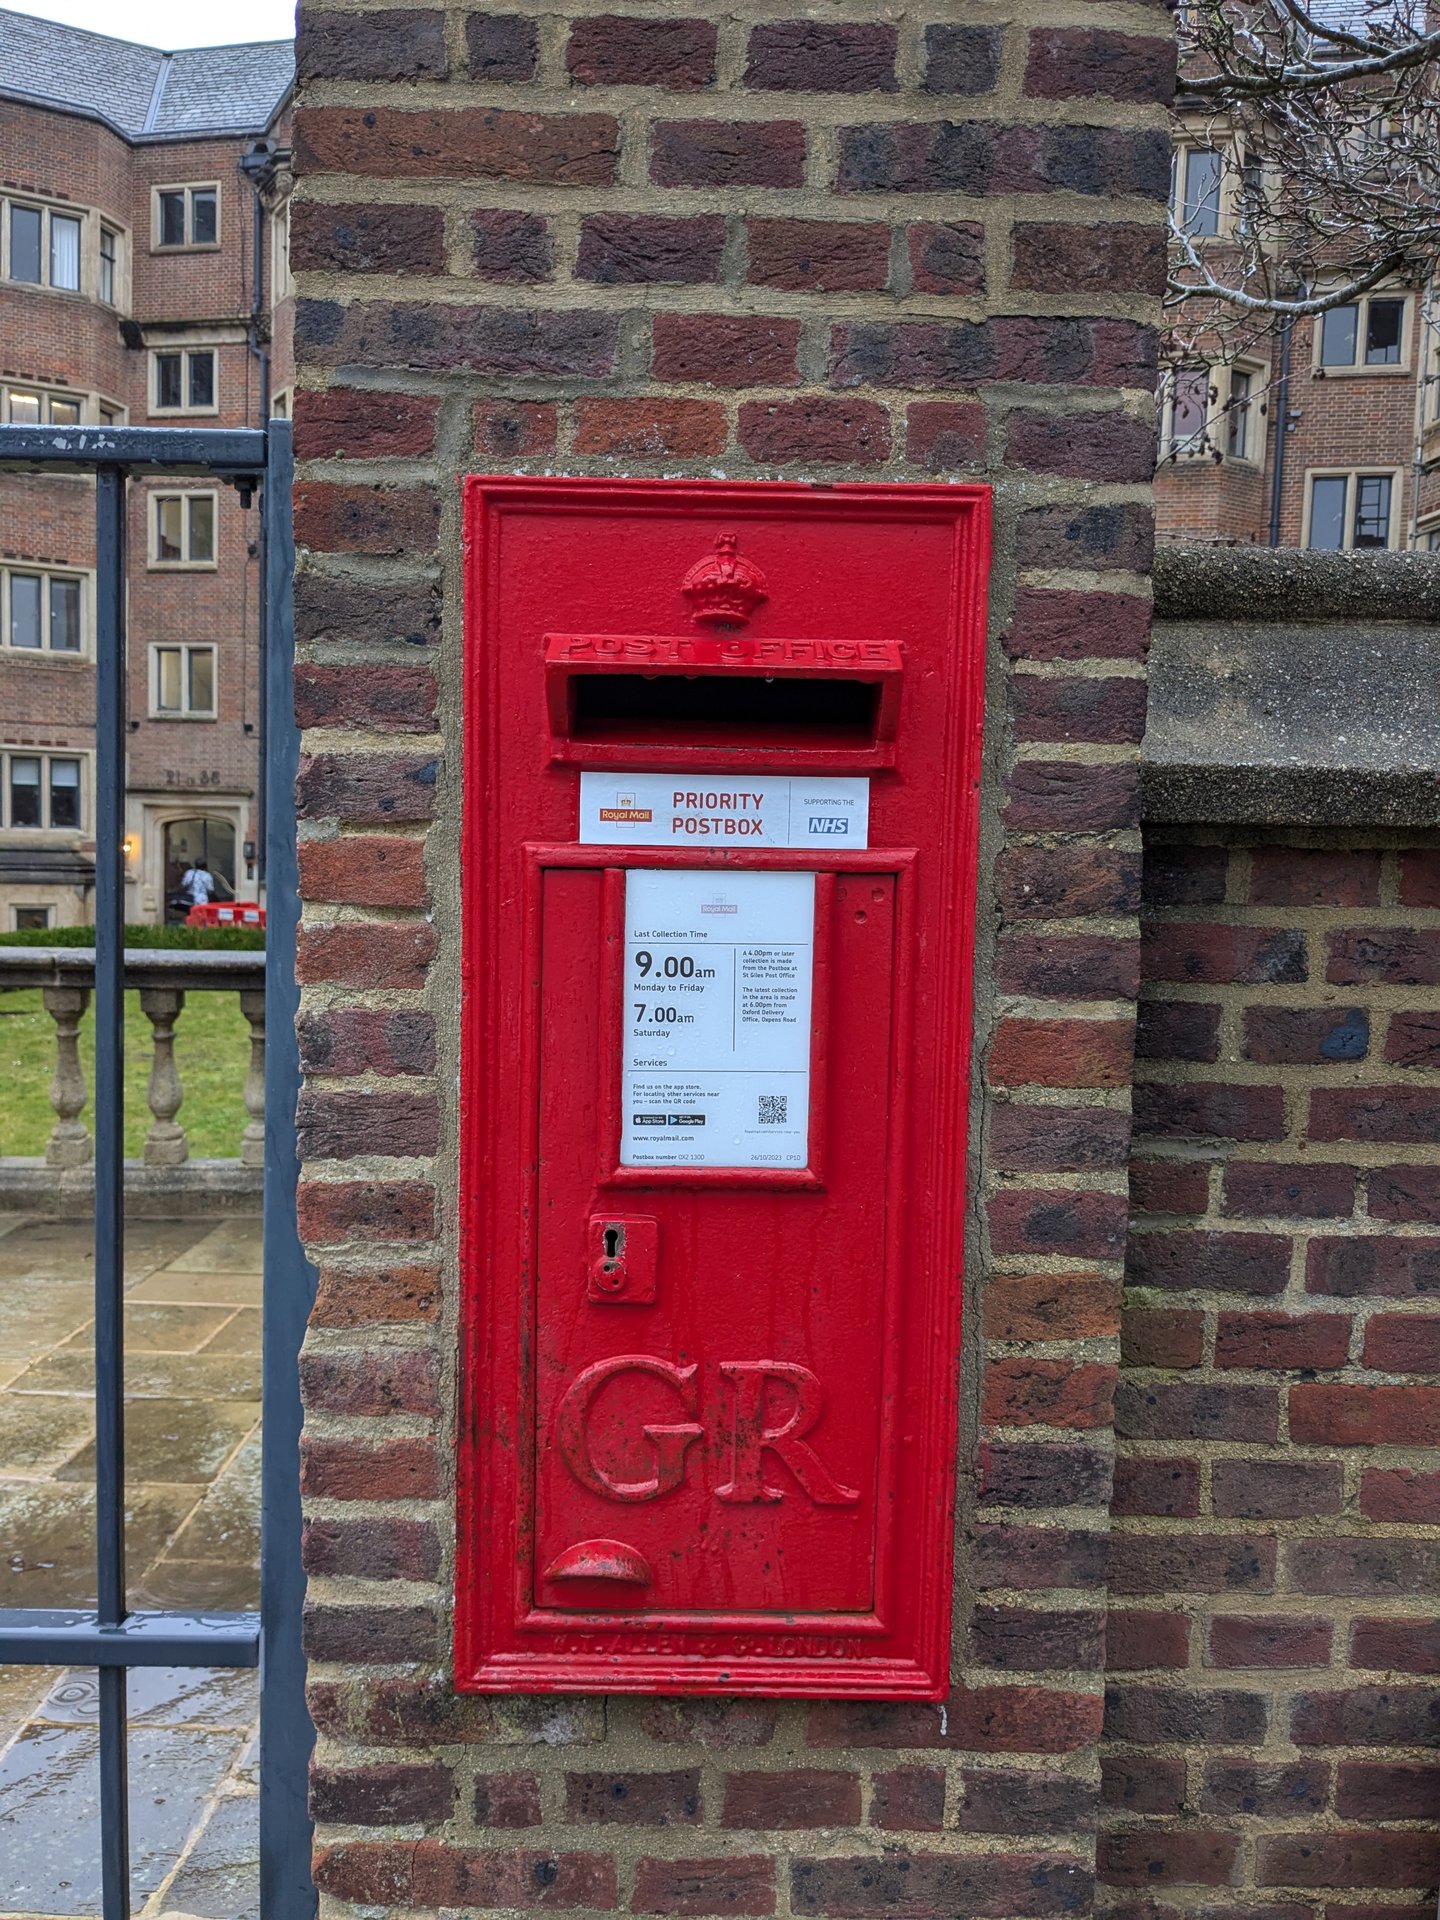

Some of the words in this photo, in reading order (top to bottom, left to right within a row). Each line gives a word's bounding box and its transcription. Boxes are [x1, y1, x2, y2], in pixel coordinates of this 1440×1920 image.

[560, 637, 691, 660] POST
[716, 641, 889, 662] OFFICE
[672, 792, 764, 810] PRIORITY
[803, 798, 842, 806] SUPPORTING
[602, 810, 628, 820] Royal
[629, 811, 650, 820] Mail
[672, 817, 763, 835] POSTBOX
[810, 818, 847, 833] NHS
[702, 905, 720, 914] Royal
[721, 905, 736, 913] Mail
[634, 930, 650, 938] Last
[748, 949, 773, 957] 4.00pm
[635, 951, 716, 978] 9.00am
[633, 983, 666, 993] Monday
[679, 984, 705, 993] Friday
[749, 1001, 773, 1009] 6.00pm
[634, 1003, 695, 1023] 7.00am
[633, 1029, 671, 1038] Saturday
[633, 1058, 668, 1067] Services
[557, 1355, 861, 1505] GR
